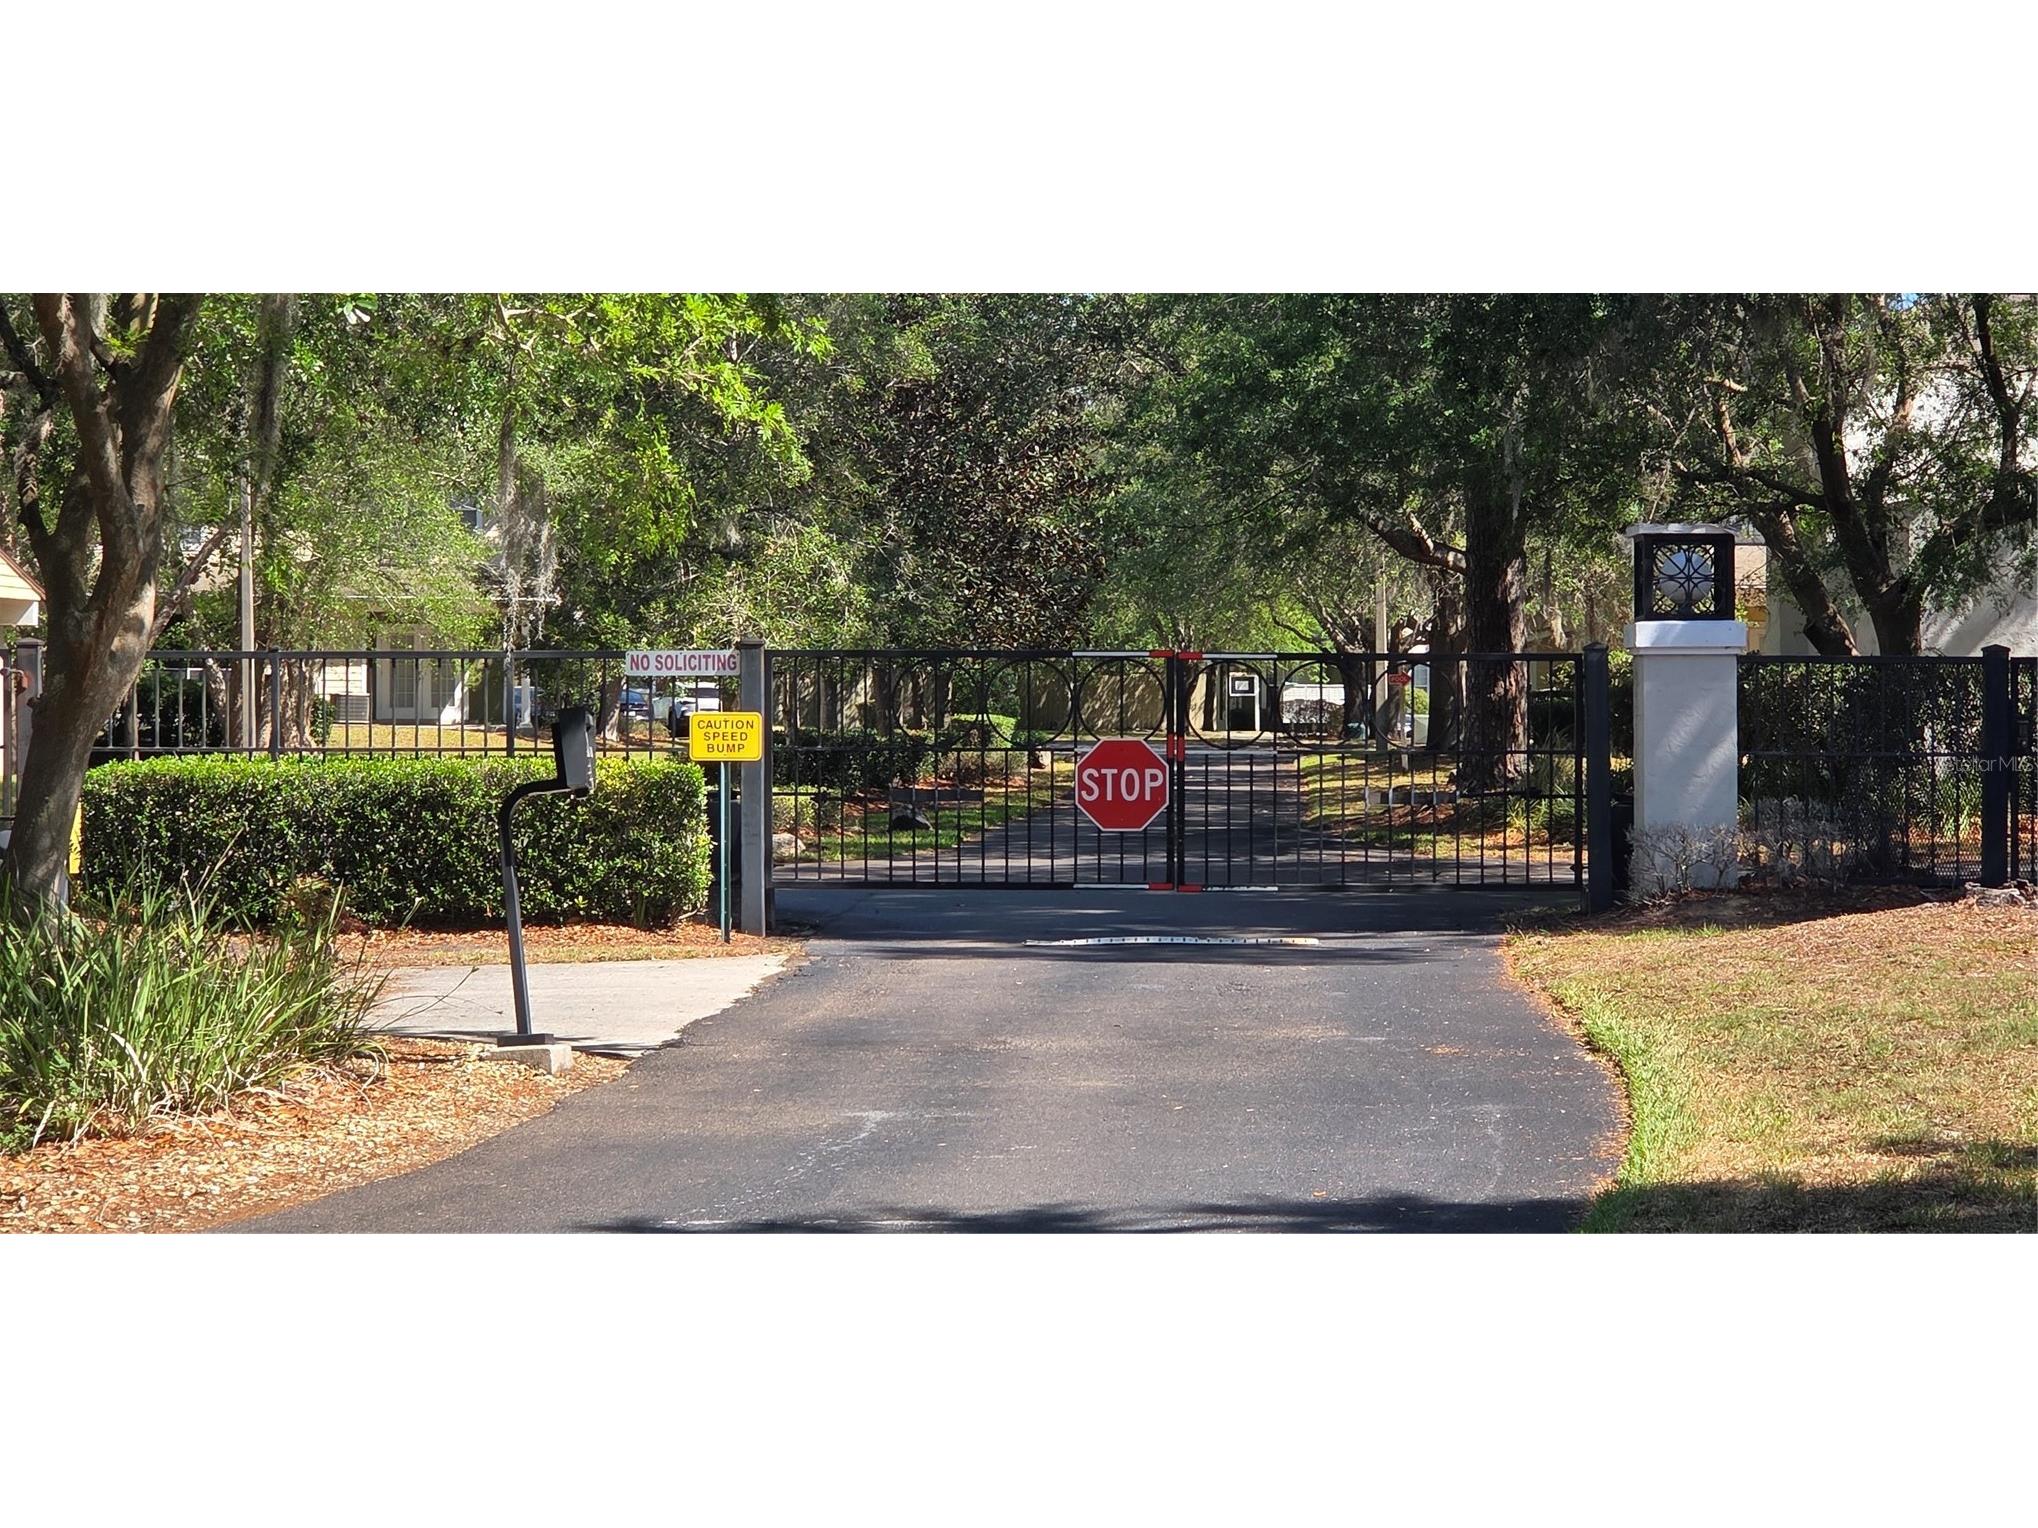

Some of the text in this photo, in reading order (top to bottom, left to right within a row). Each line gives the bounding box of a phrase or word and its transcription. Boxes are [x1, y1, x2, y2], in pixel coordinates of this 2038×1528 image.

[630, 654, 738, 671] NO SOLICITING
[697, 719, 755, 730] CAUTION
[703, 731, 748, 742] SPEED
[707, 743, 745, 753] BUMP
[1081, 767, 1164, 802] STOP
